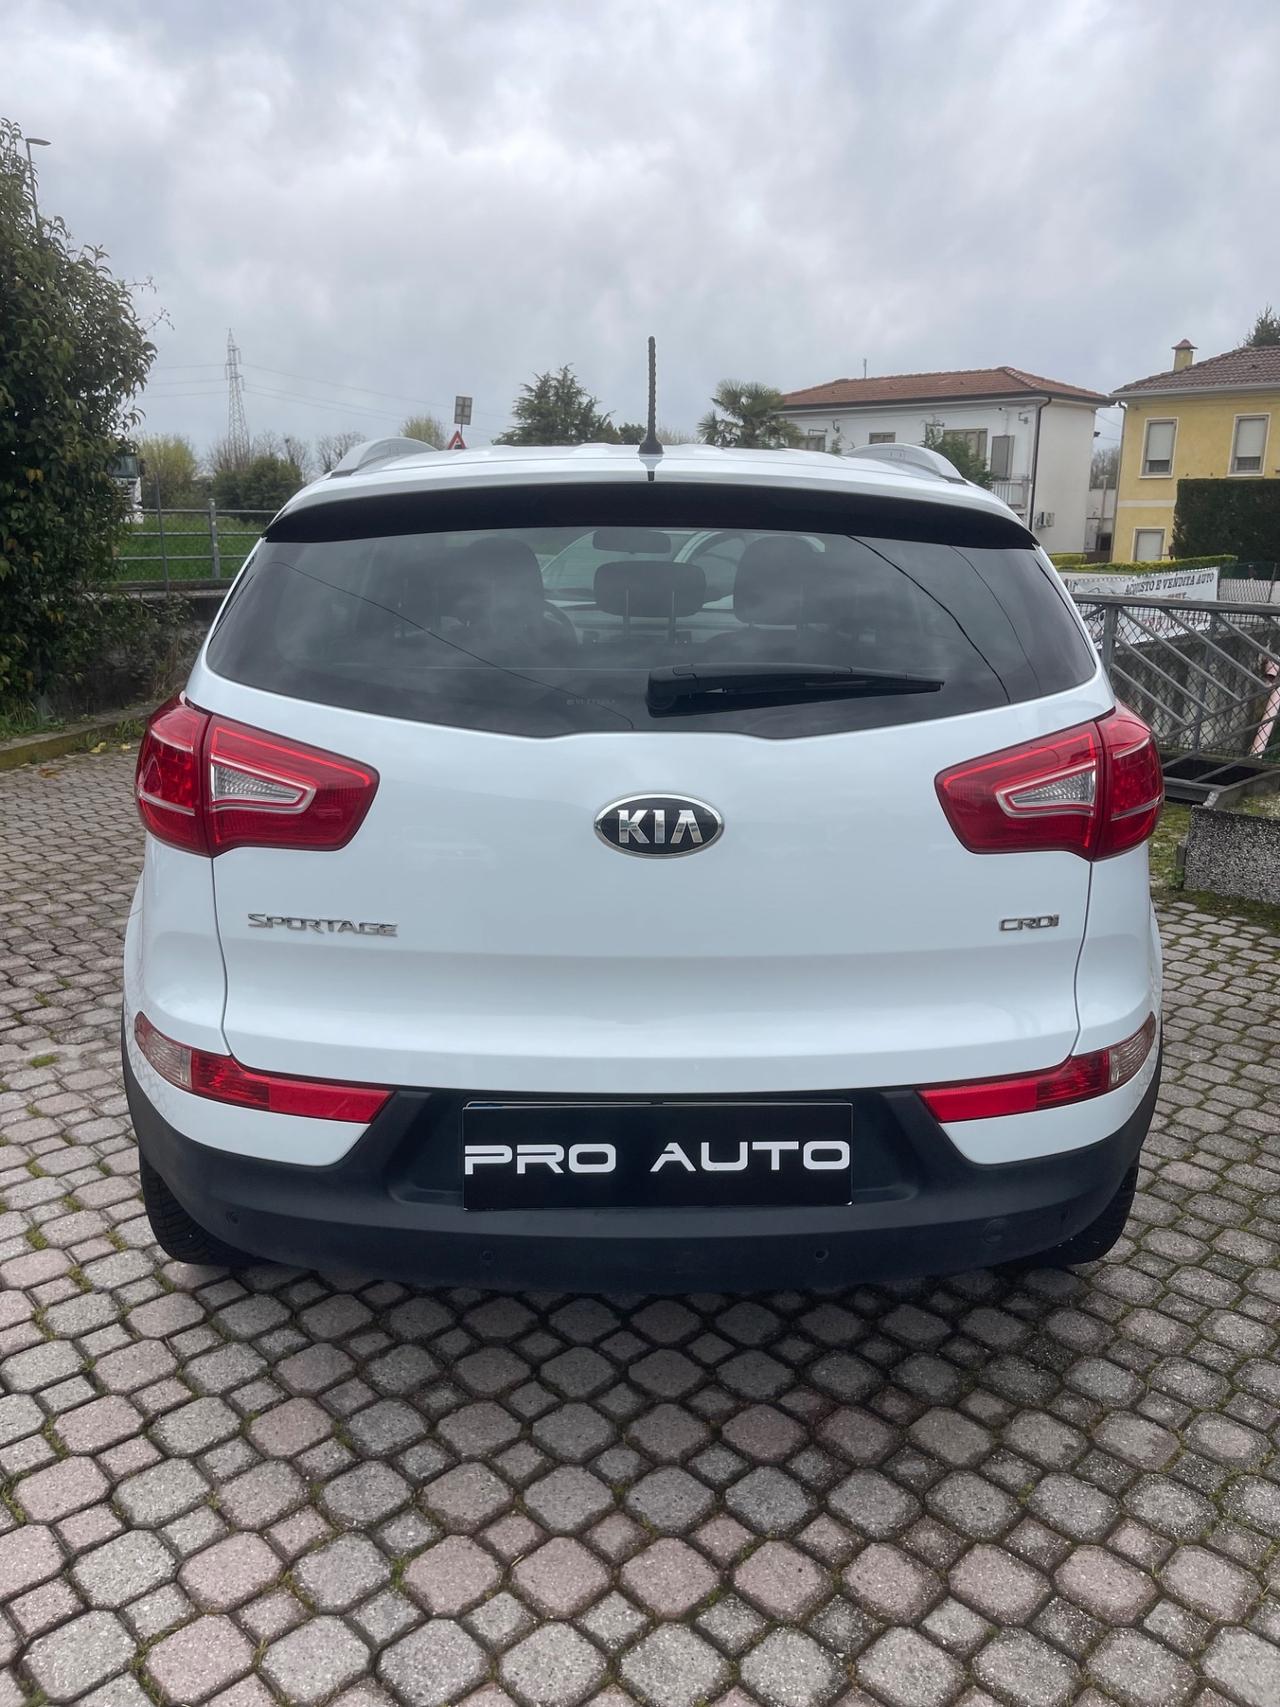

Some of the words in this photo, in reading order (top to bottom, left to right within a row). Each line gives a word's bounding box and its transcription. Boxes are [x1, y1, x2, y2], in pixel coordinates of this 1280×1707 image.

[1196, 572, 1214, 584] AUTO
[617, 809, 703, 844] KIA
[247, 913, 398, 937] SPORTAGE
[464, 1143, 617, 1175] PRO
[650, 1140, 850, 1172] AUTO
